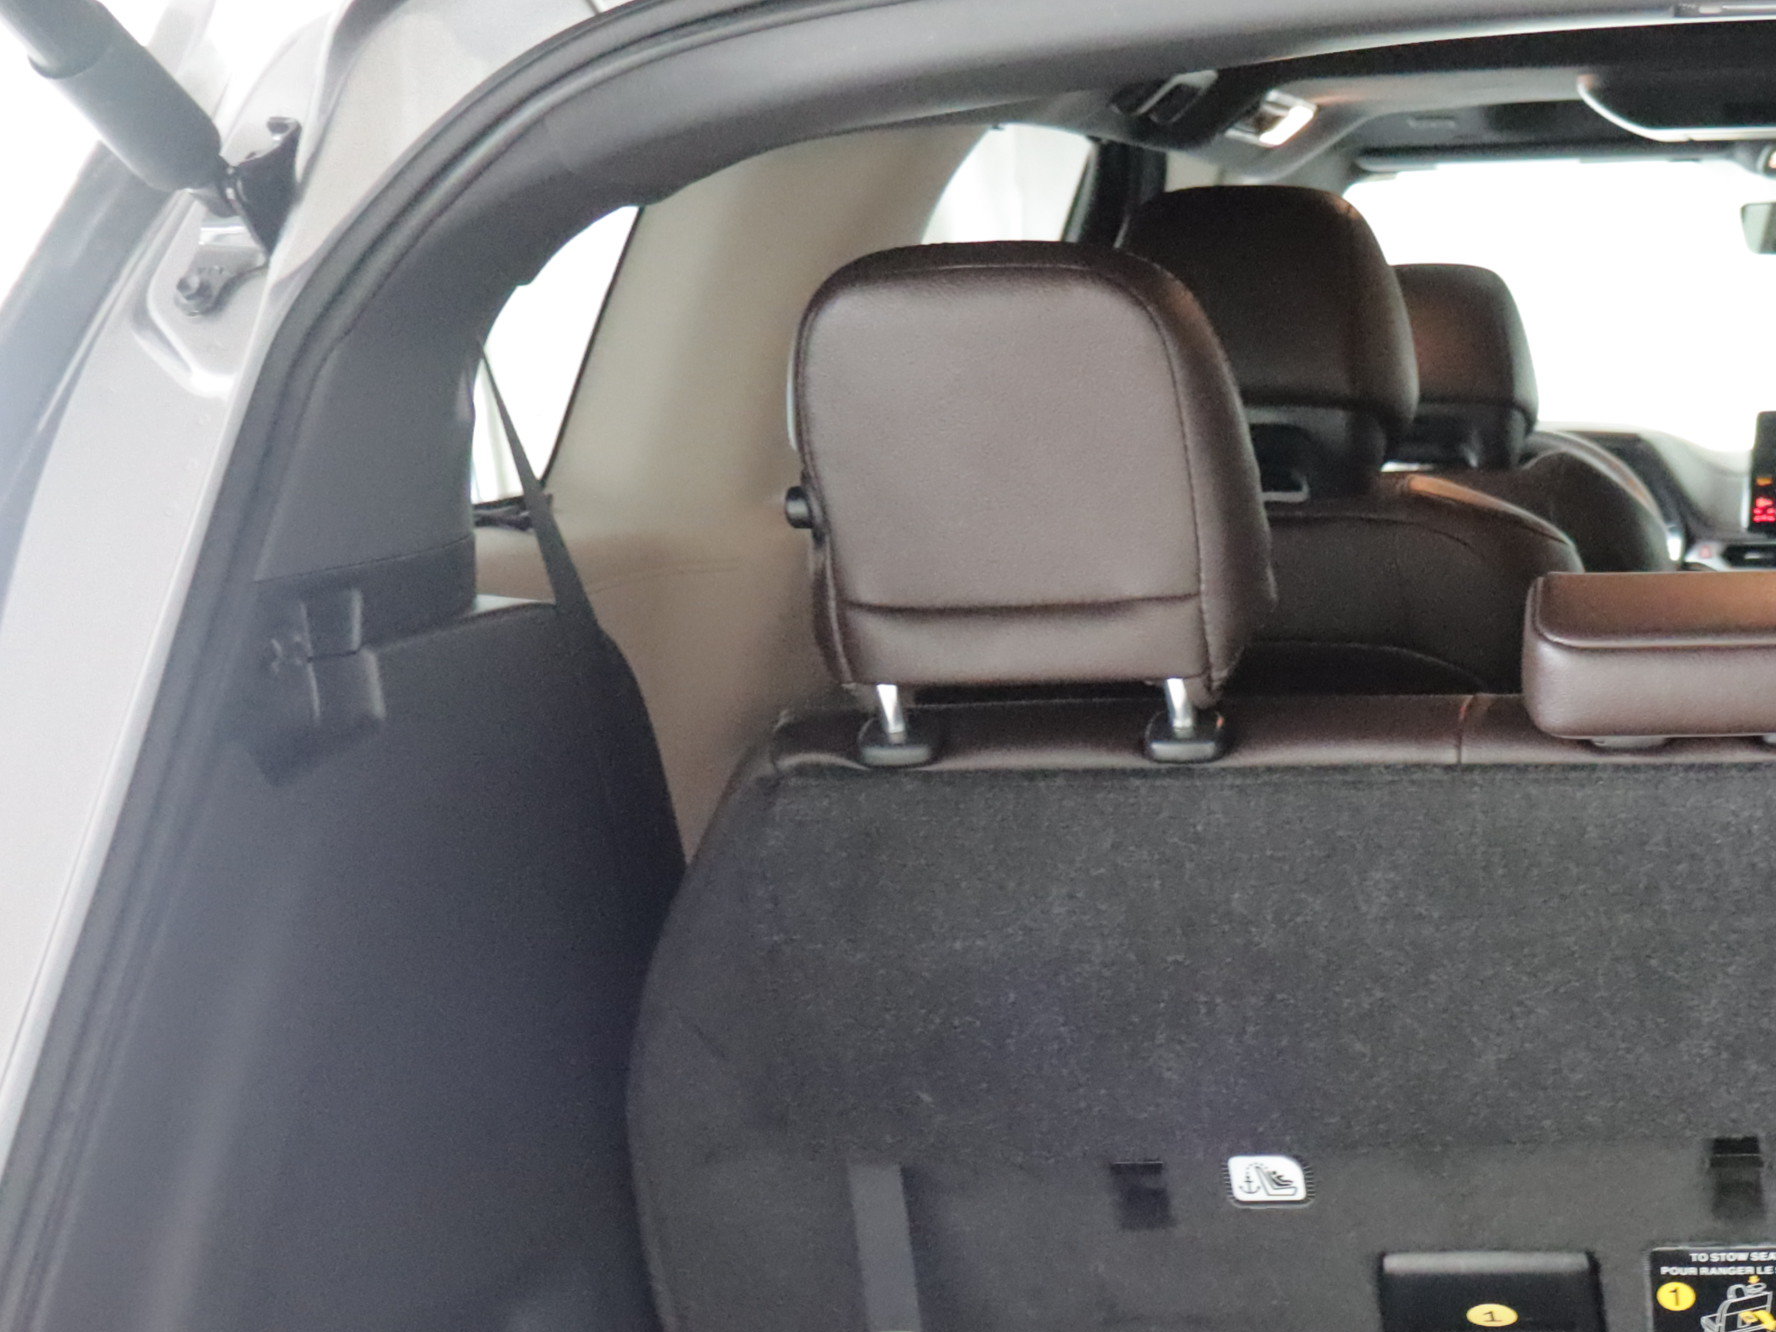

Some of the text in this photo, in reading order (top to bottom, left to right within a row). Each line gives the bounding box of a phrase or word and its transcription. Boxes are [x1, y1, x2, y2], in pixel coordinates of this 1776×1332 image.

[1690, 1253, 1709, 1262] TO
[1709, 1252, 1749, 1262] STOW
[1660, 1266, 1698, 1275] POUR
[1699, 1265, 1756, 1275] RANGER
[1756, 1265, 1774, 1274] LE
[1669, 1286, 1680, 1307] 1
